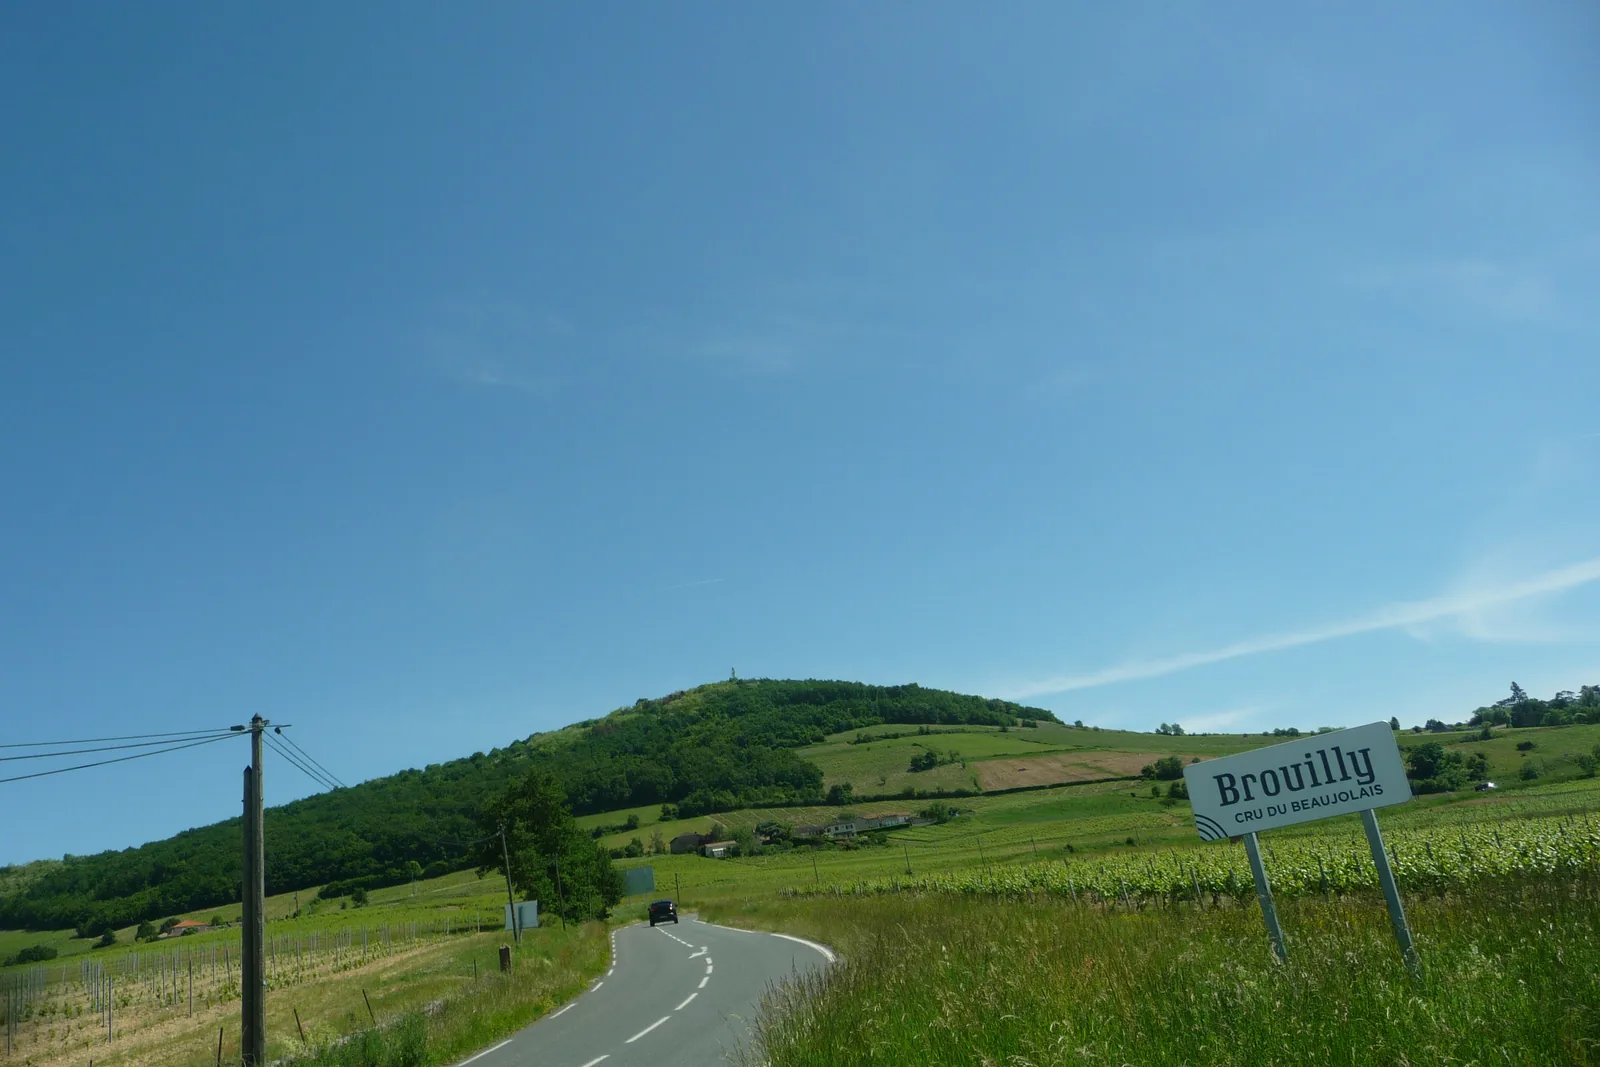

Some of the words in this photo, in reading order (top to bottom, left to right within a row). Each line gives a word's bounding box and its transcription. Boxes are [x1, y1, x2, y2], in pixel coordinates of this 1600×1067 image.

[1212, 746, 1376, 807] Brouilly
[1234, 807, 1264, 824] CRU
[1267, 804, 1288, 817] DU
[1291, 784, 1384, 812] BEAUJOLAIS
